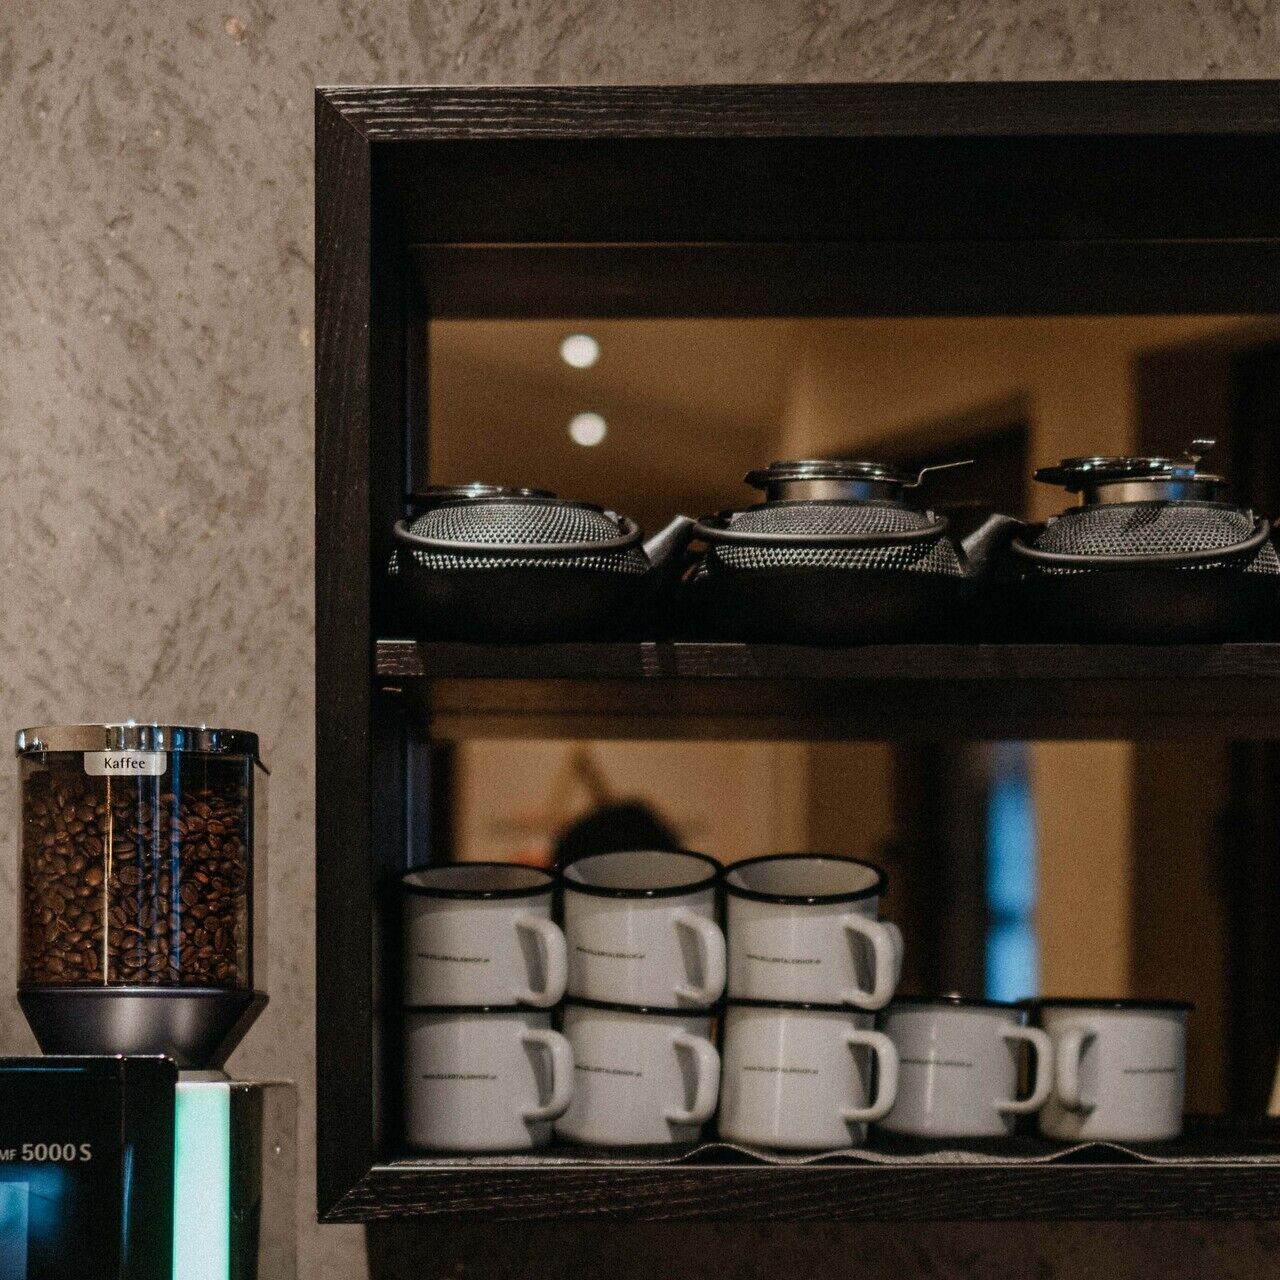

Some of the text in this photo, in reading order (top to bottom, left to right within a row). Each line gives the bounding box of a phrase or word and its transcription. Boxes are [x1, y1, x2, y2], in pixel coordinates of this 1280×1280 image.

[103, 755, 146, 770] Kaffee
[21, 1143, 77, 1162] 5000
[79, 1143, 93, 1162] S
